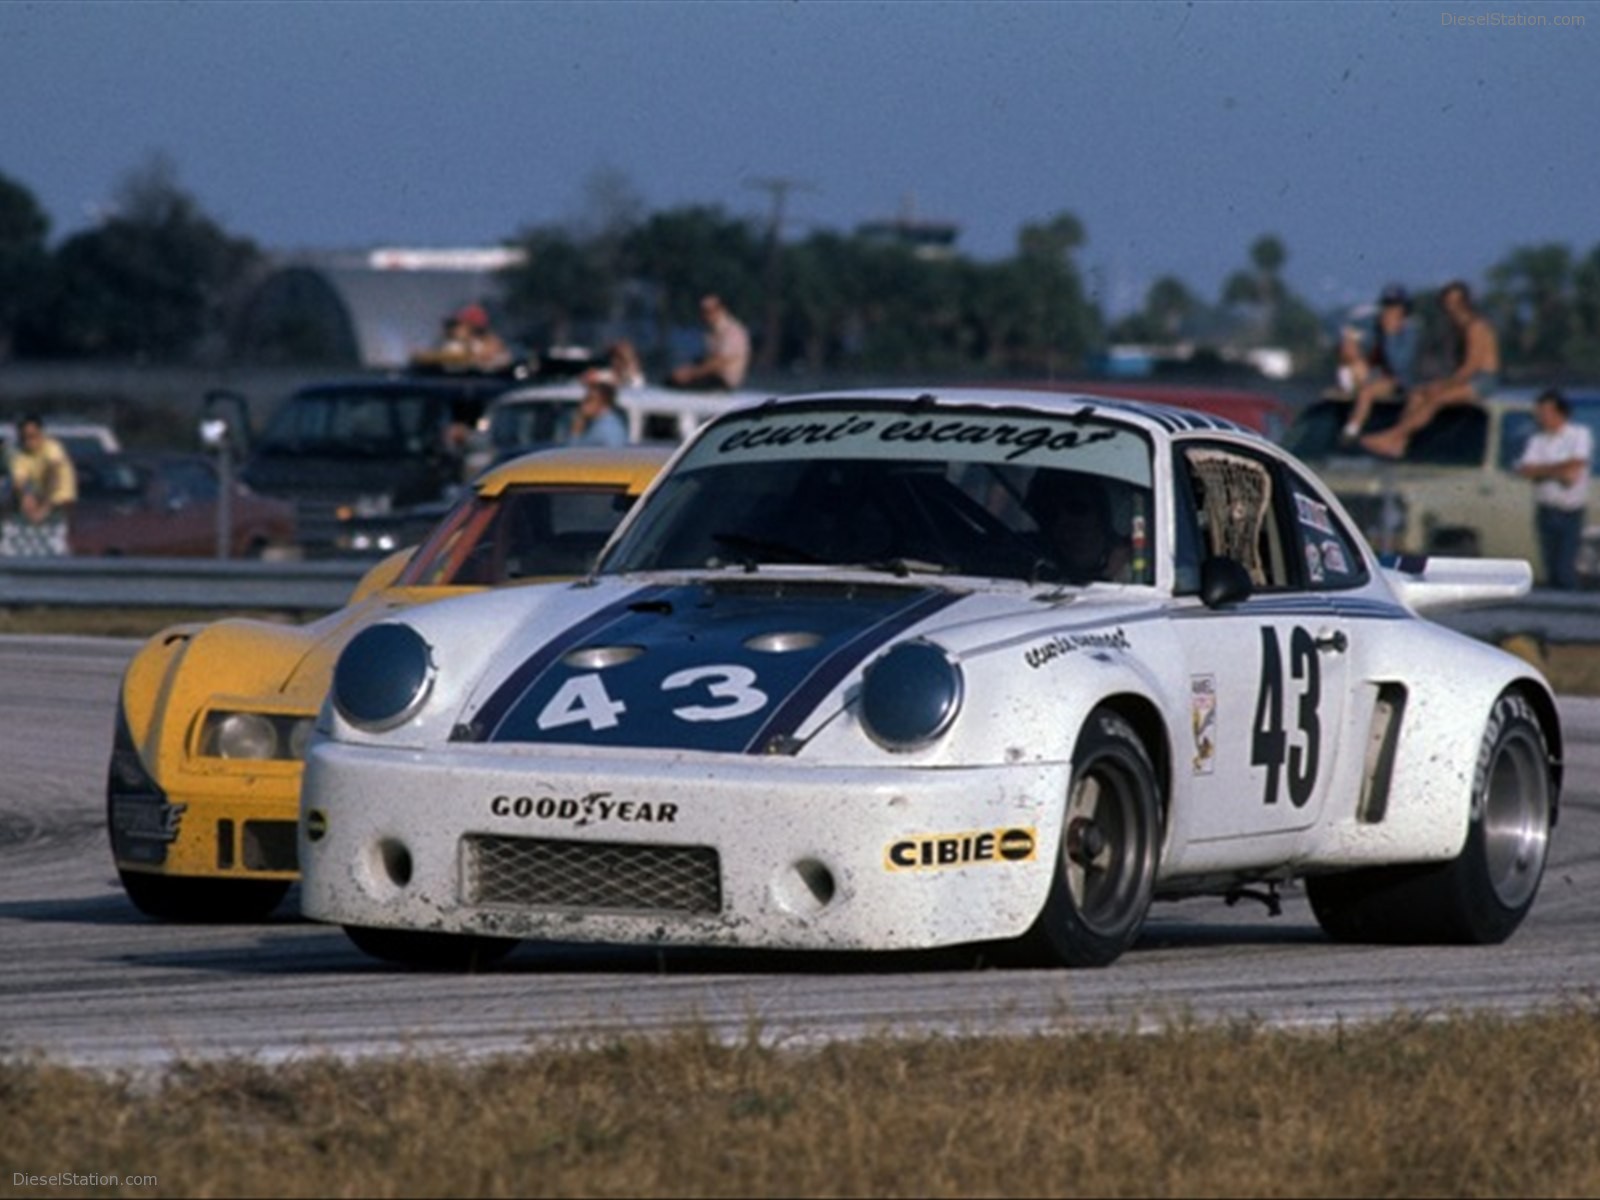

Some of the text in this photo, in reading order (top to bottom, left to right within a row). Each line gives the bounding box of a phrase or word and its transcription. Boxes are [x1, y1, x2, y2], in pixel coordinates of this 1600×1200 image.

[718, 414, 876, 454] ecurie
[1250, 625, 1321, 810] 43
[889, 832, 996, 867] CIBIE
